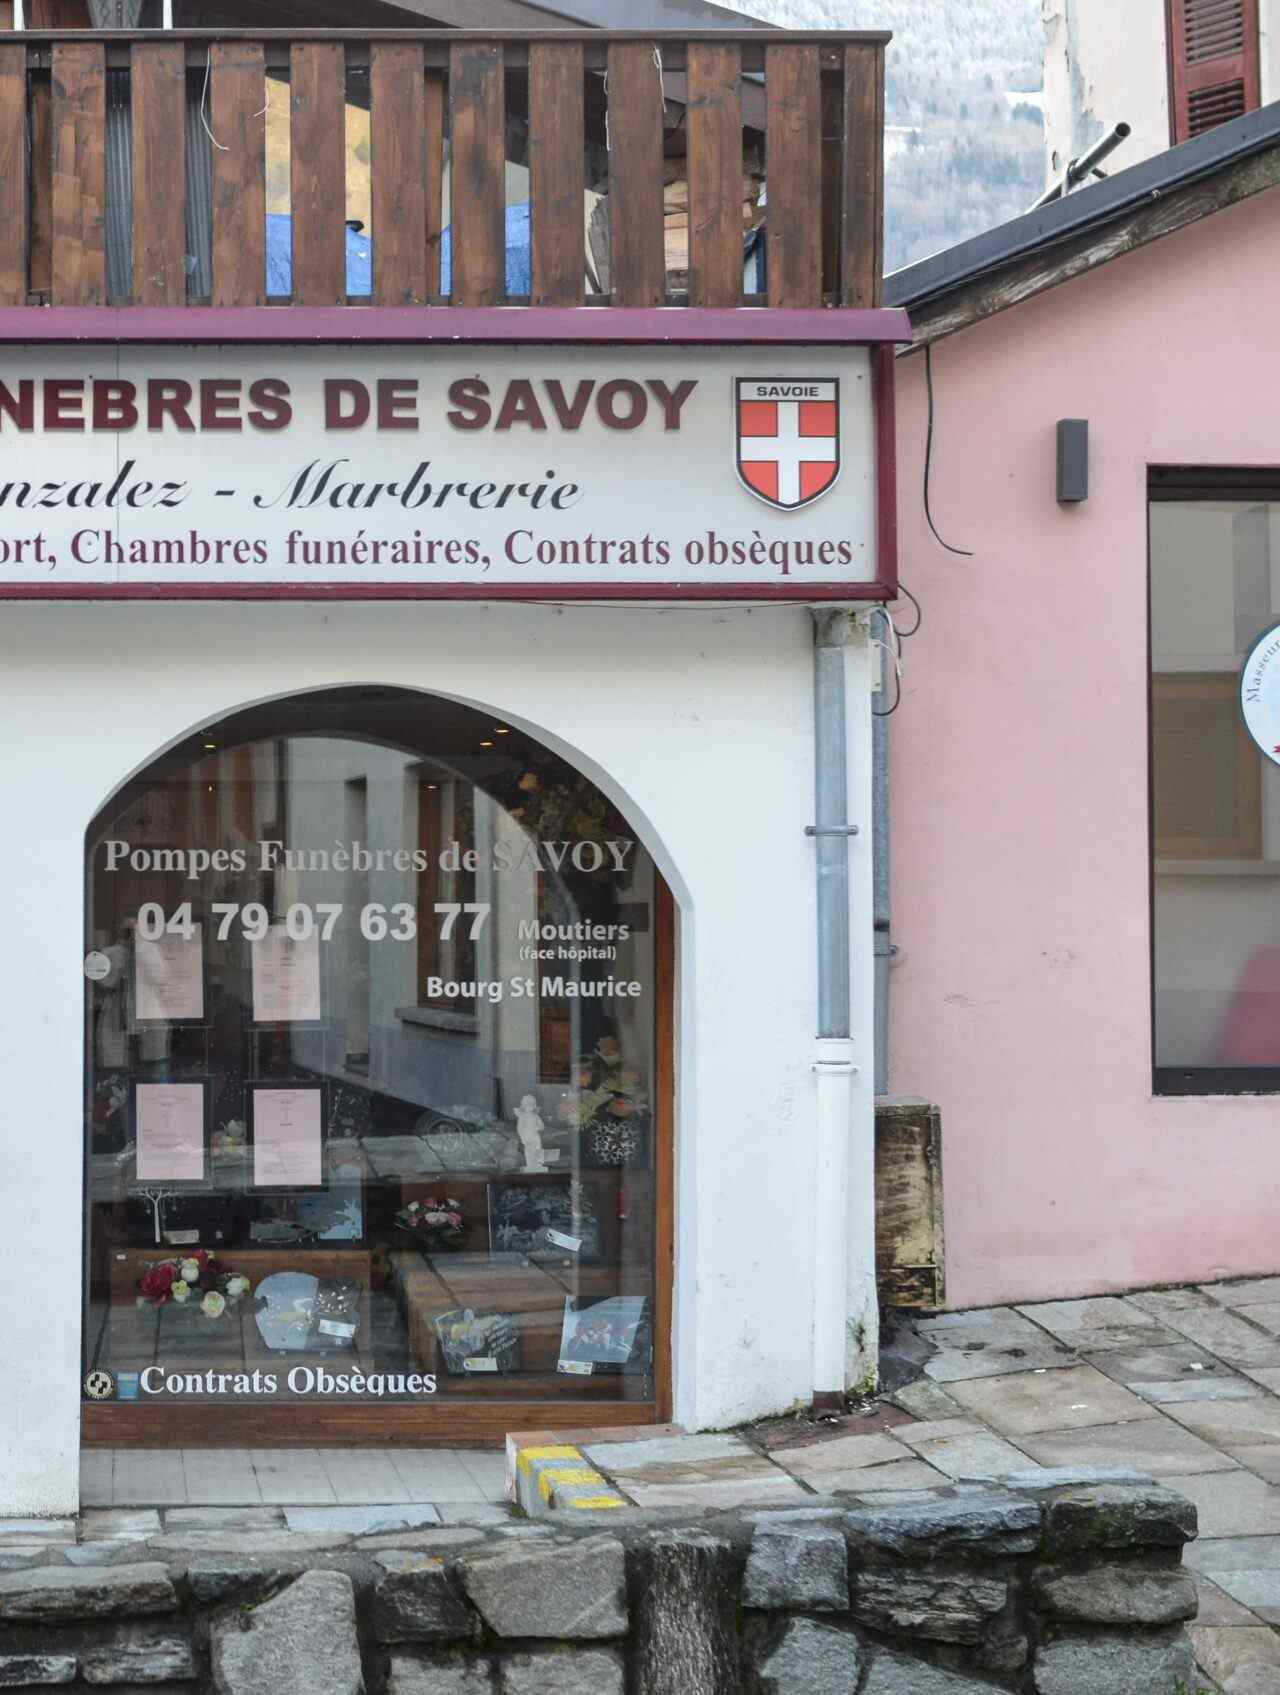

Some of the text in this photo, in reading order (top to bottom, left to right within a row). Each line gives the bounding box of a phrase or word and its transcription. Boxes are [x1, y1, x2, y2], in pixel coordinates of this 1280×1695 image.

[324, 379, 420, 431] DE
[447, 377, 699, 432] SAVOY
[756, 386, 820, 397] SAVOIE
[253, 458, 583, 510] Marbrerie
[70, 529, 268, 565] Chambres
[285, 529, 491, 571] funéraires,
[504, 529, 671, 566] Contrats
[685, 530, 852, 575] obsèques
[104, 839, 635, 880] Pompes Funèbres de SAVOY
[137, 902, 491, 942] 04 79 07 63 77
[517, 919, 630, 942] Moutiers
[519, 945, 617, 962] (face hôpital)
[426, 975, 642, 1003] Bourg St Maurice
[140, 1366, 279, 1395] Contrats
[287, 1365, 438, 1397] Obsèques
